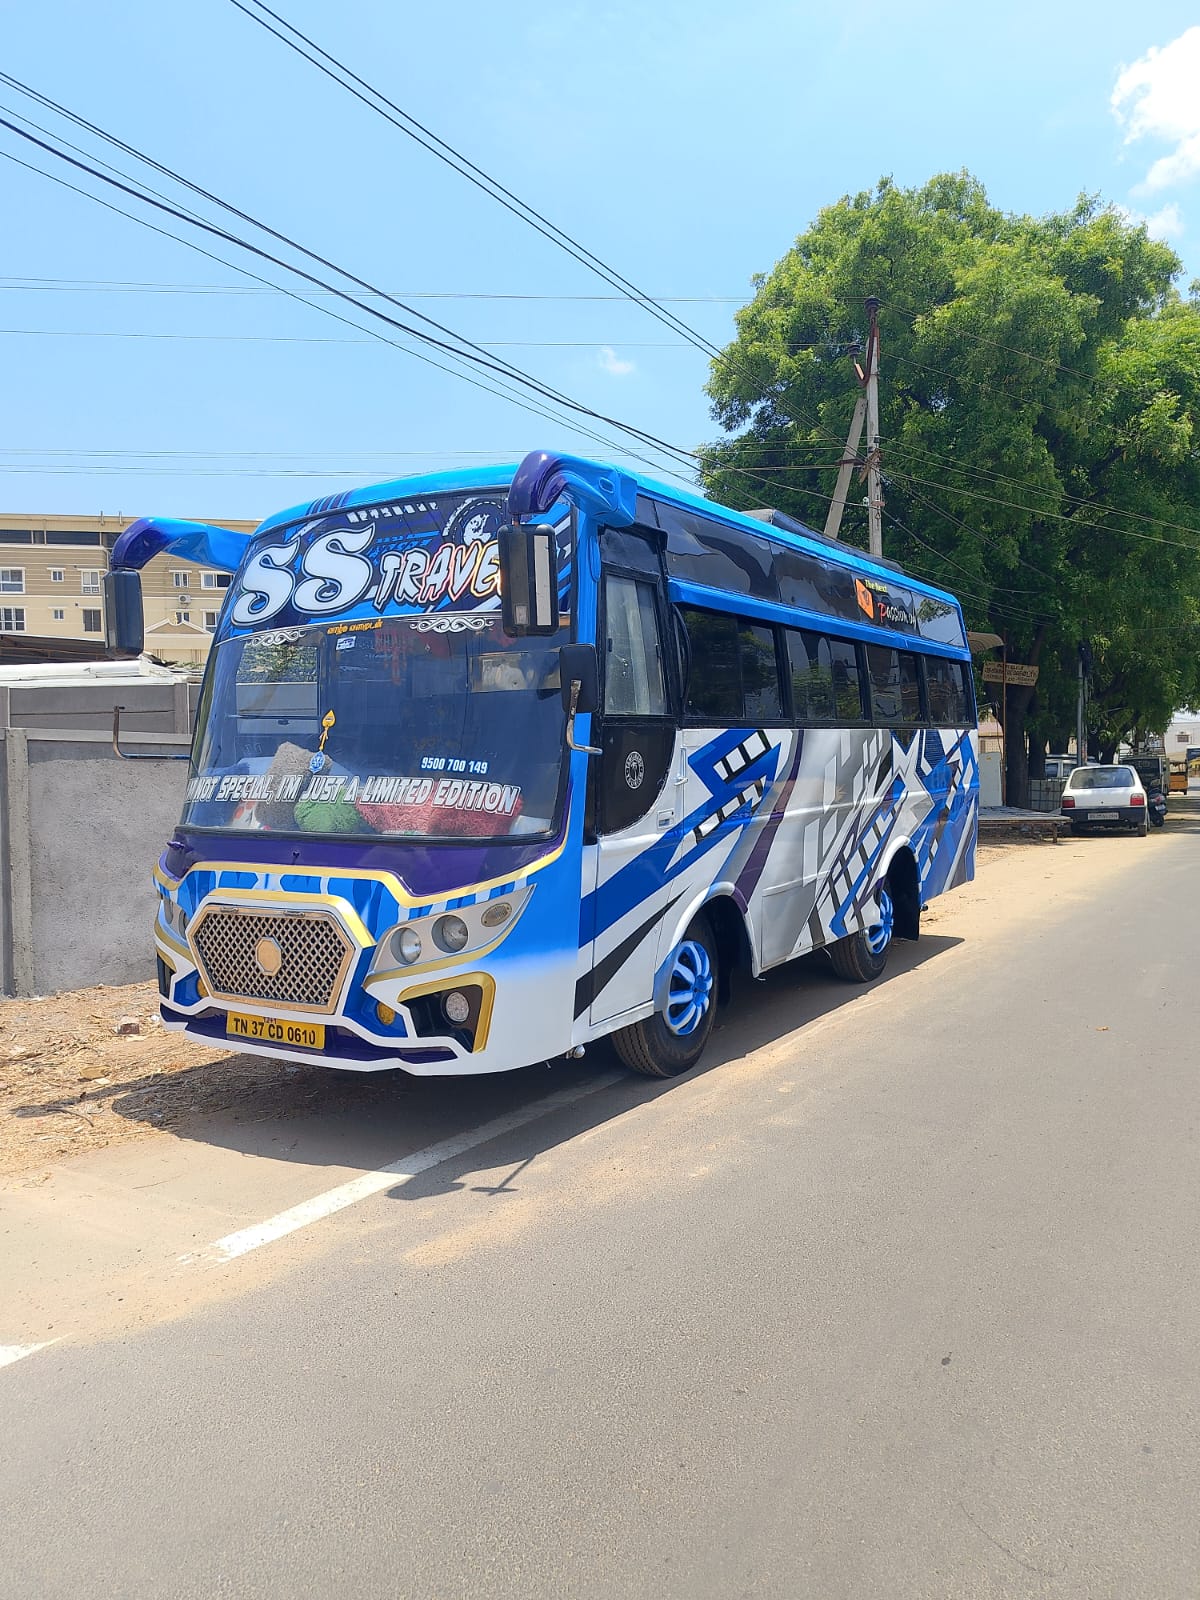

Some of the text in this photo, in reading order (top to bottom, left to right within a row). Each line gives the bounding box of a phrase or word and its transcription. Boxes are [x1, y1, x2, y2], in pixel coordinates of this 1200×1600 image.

[372, 540, 502, 615] TRAVE
[421, 756, 489, 774] 9500 700 149
[193, 775, 221, 803] NOT
[299, 774, 348, 803] JUST
[342, 775, 361, 803] A
[359, 775, 434, 805] LIMITED
[431, 778, 522, 816] EDITION
[233, 1017, 316, 1045] TN 37 CD 0610
